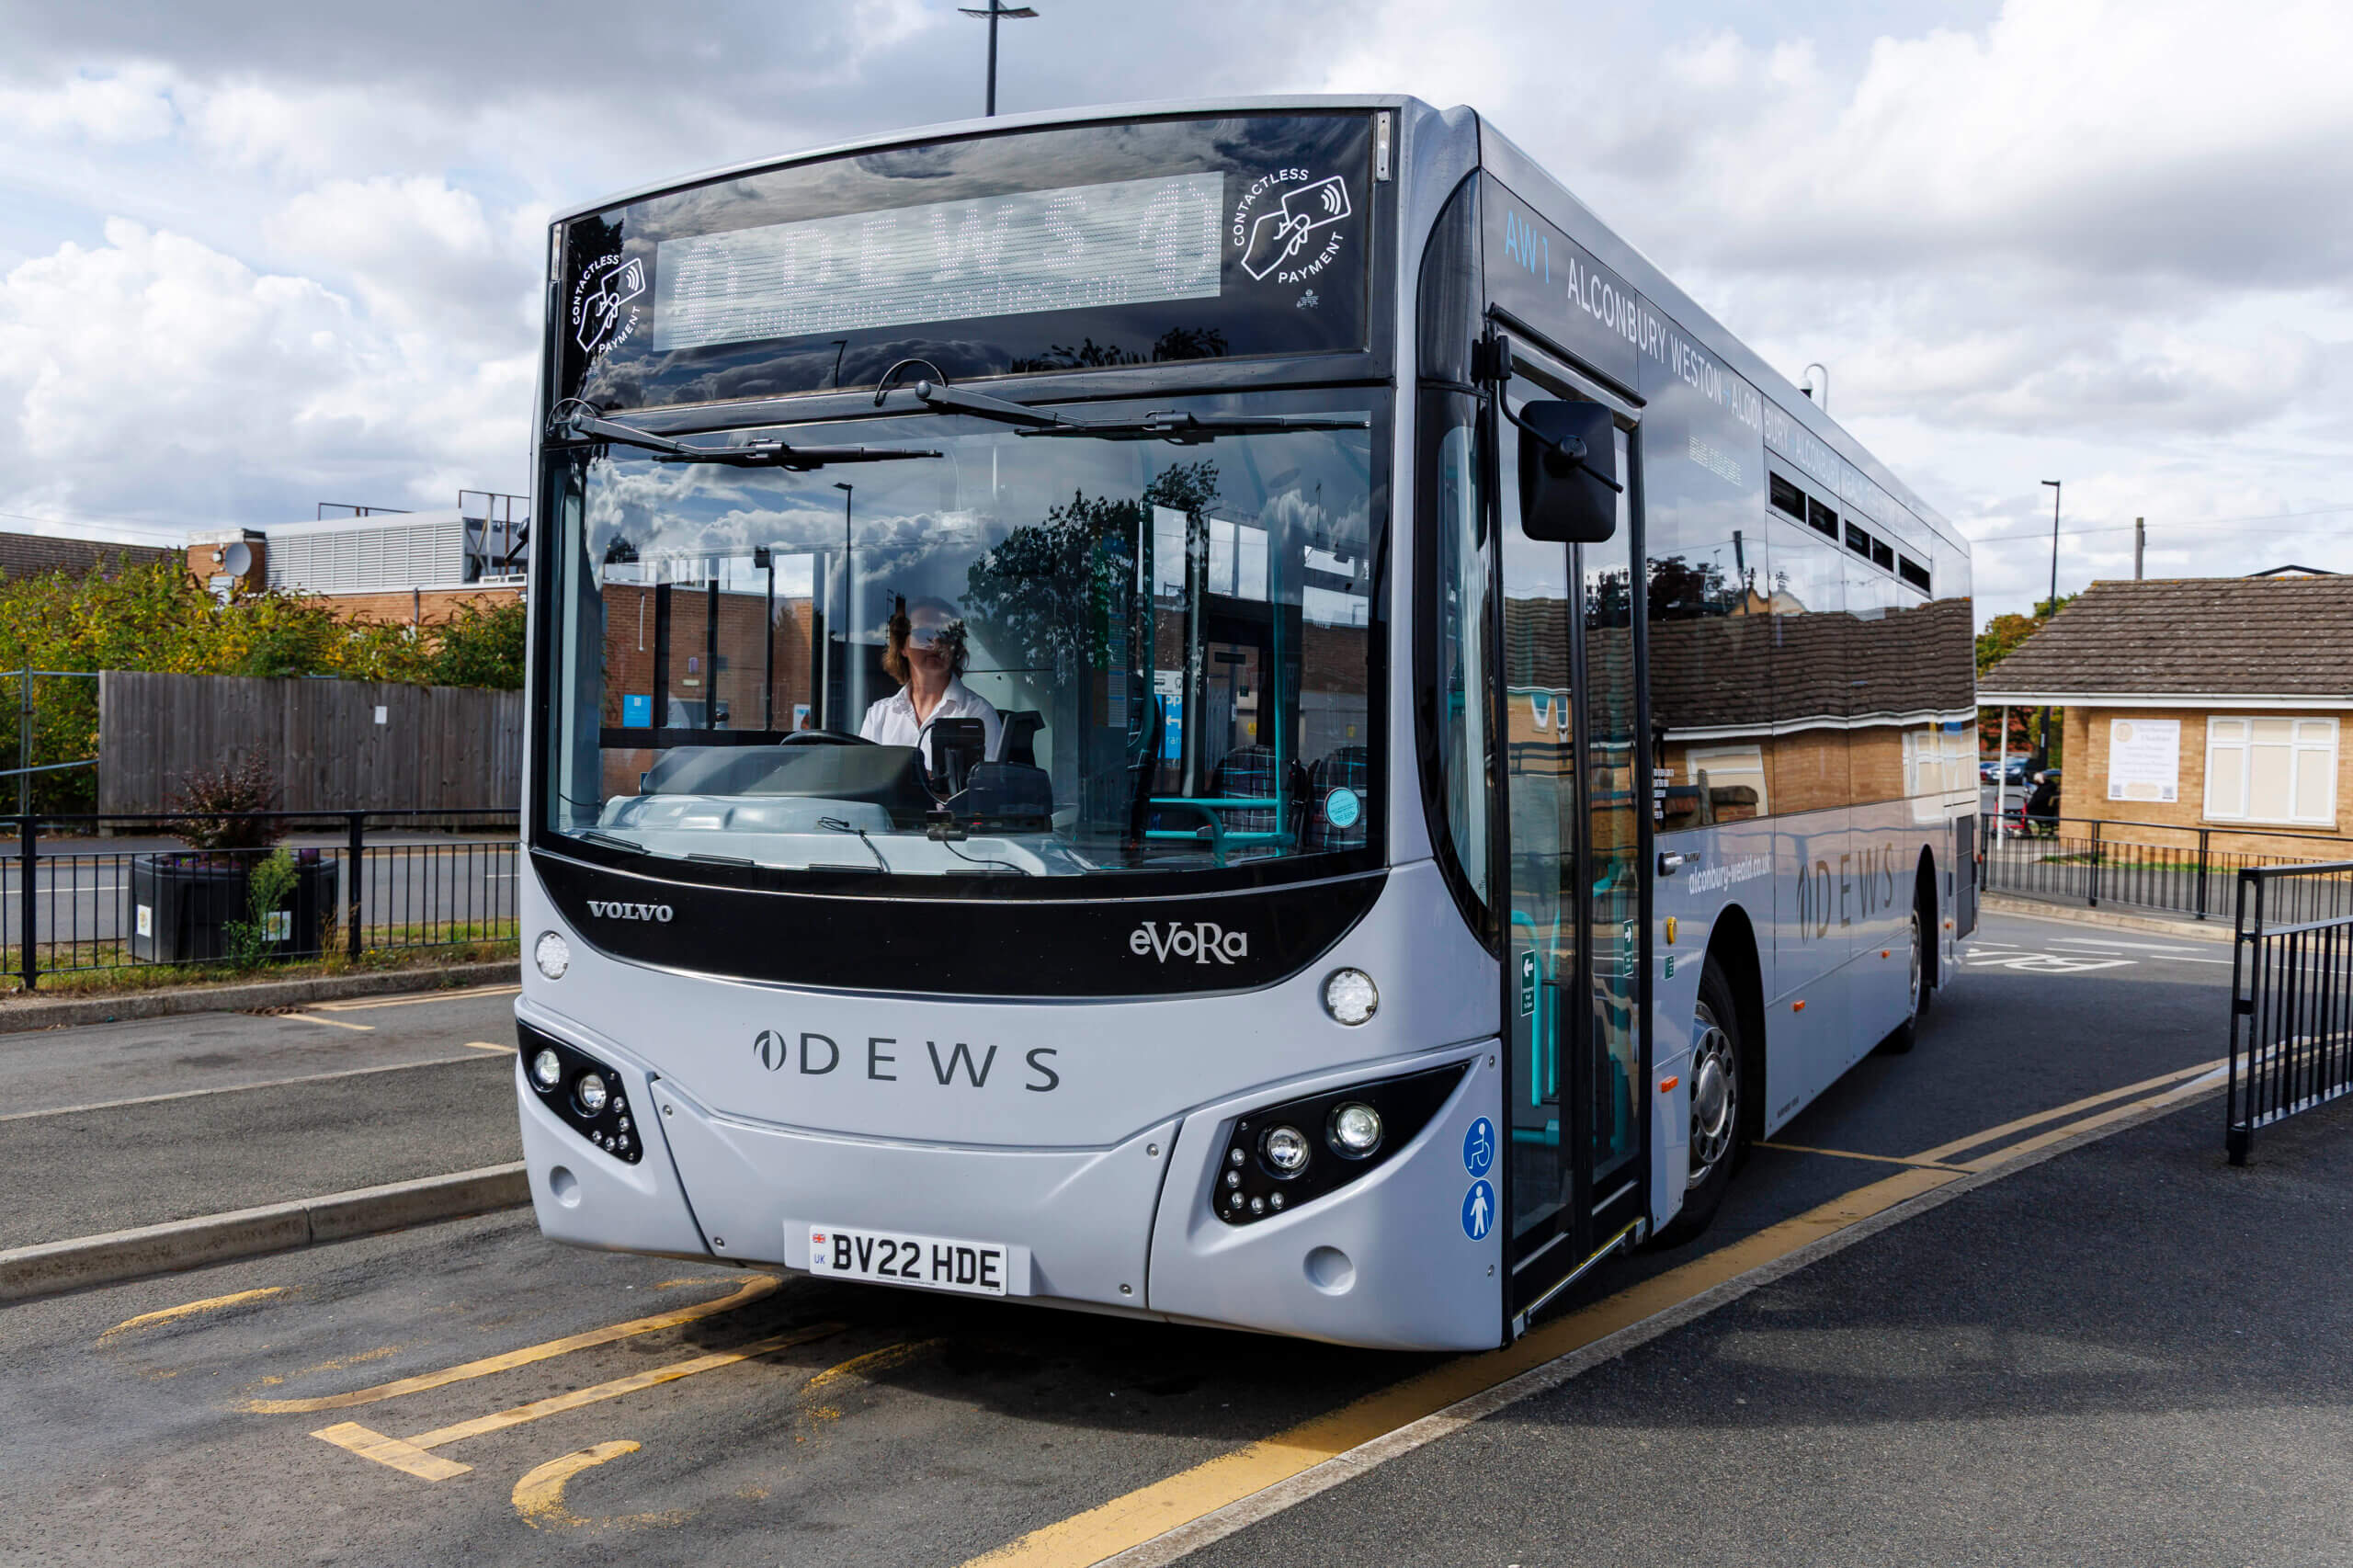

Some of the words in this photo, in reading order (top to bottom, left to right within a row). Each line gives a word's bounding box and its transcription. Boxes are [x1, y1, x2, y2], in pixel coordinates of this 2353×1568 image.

[1234, 168, 1310, 247] CONTACTLESS
[780, 196, 1087, 296] DEWS
[1278, 231, 1345, 284] PAYMENT
[1505, 210, 1550, 285] AW1
[573, 255, 620, 325] CONTACTLESS
[598, 305, 641, 354] PAYMENT
[1567, 257, 1666, 364] ALCONBURY
[1670, 334, 1722, 405] WESTON
[1731, 382, 1789, 452] ALCONBURY
[1688, 850, 1770, 896] alconbury-weald.co.uk
[1816, 842, 1893, 940] DEWS
[586, 900, 674, 923] VOLVO
[800, 1032, 1061, 1093] DEWS
[813, 1253, 825, 1266] UK
[832, 1233, 921, 1279] BV22
[932, 1244, 1001, 1289] HDE
